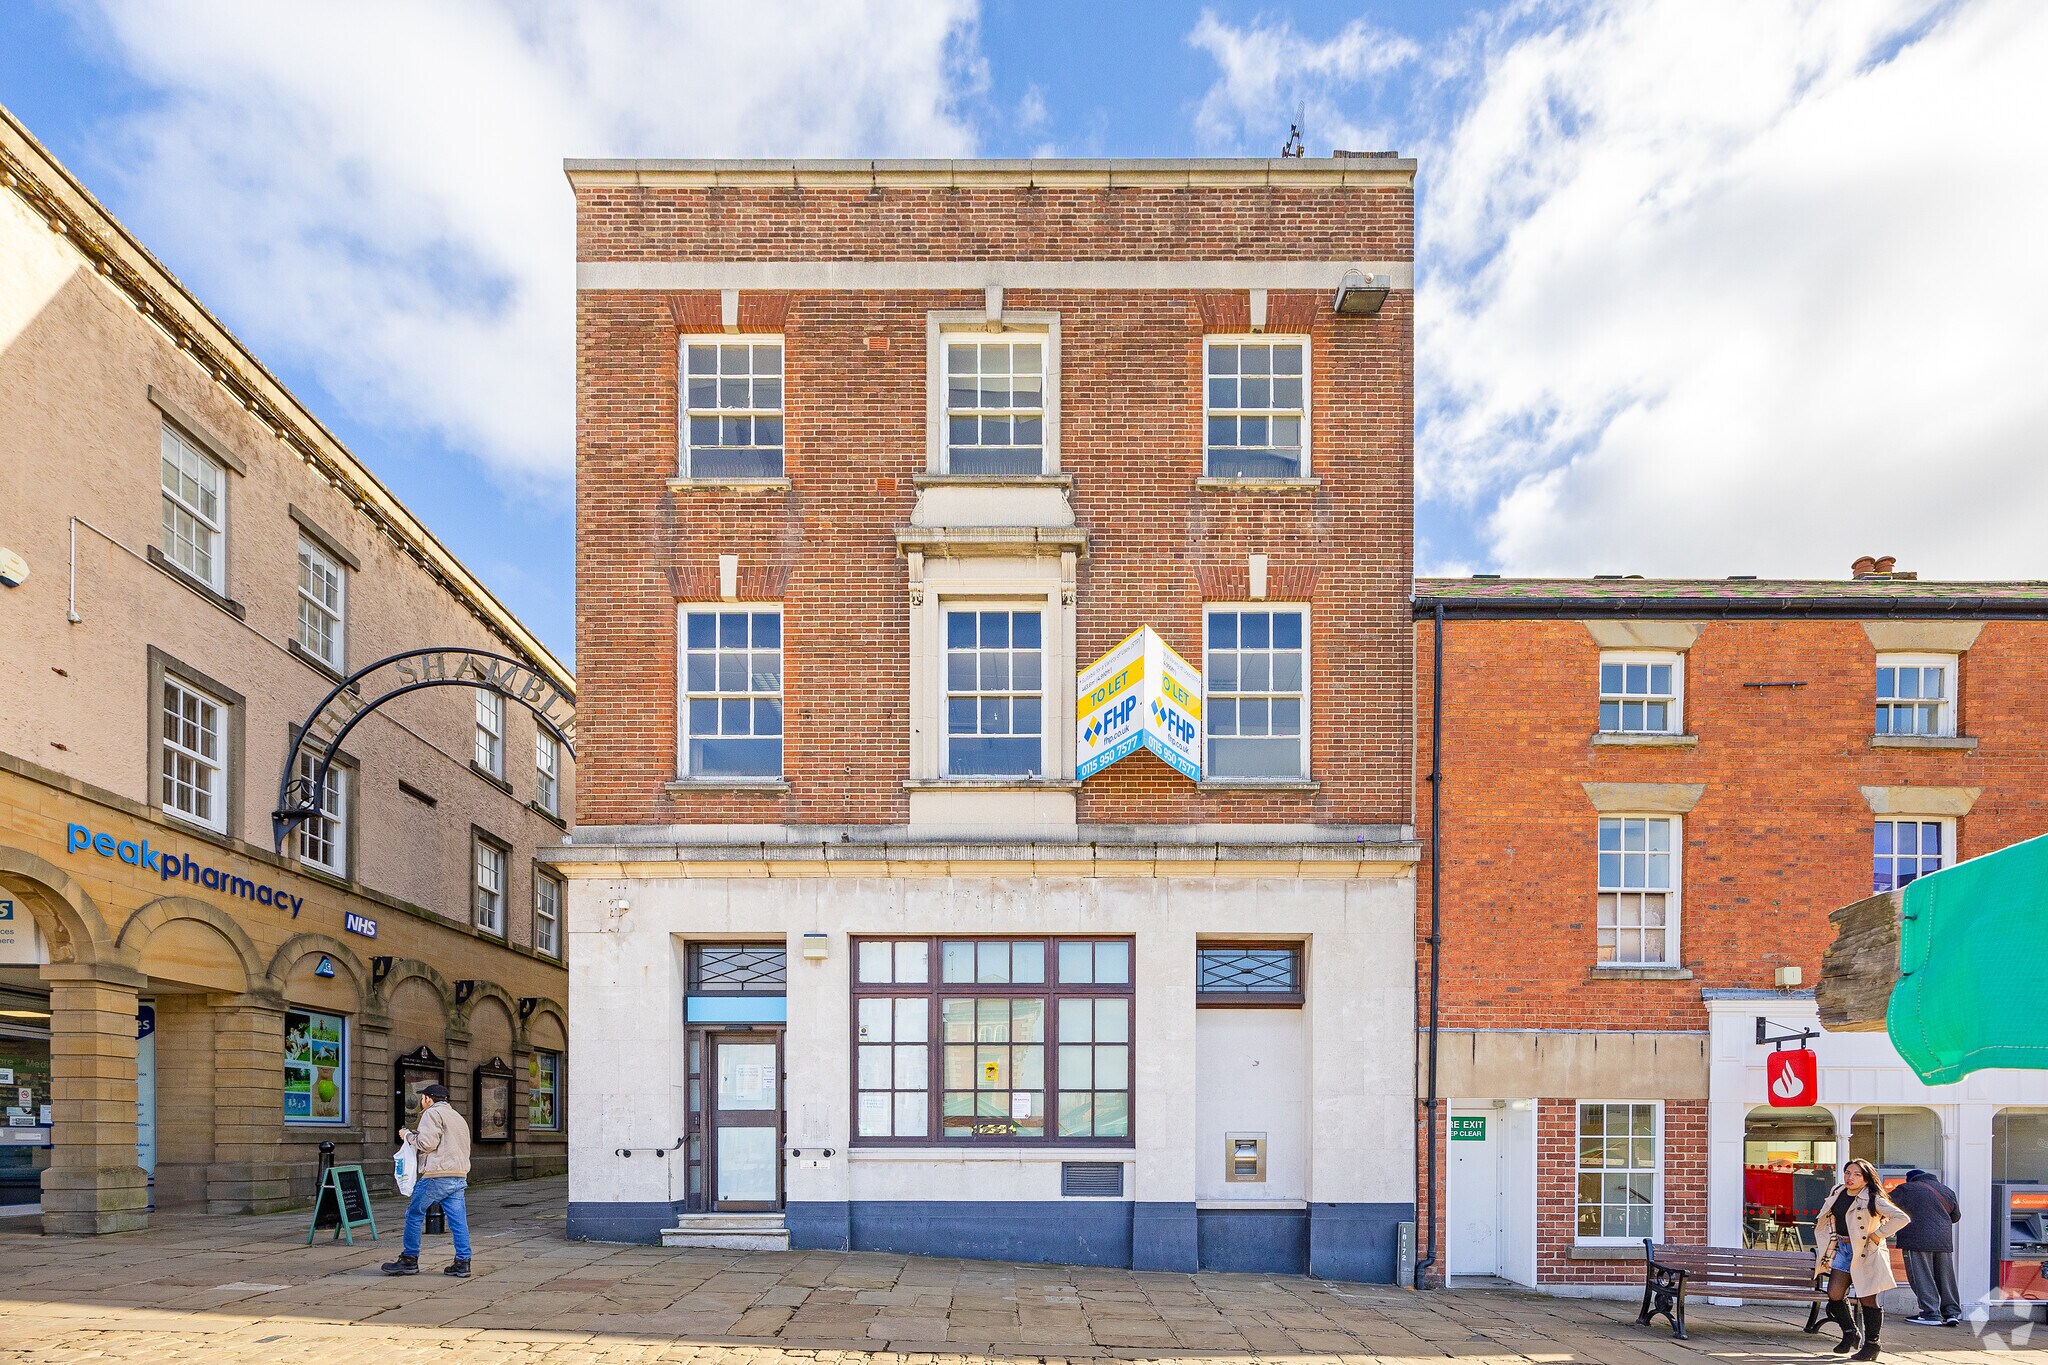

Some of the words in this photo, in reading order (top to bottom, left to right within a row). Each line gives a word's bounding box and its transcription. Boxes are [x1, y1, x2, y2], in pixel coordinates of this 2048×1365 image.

[299, 684, 368, 754] THE
[396, 651, 576, 752] SHAMBLE
[1090, 687, 1106, 707] TO
[1108, 670, 1128, 695] LET
[1162, 676, 1171, 691] O
[1173, 683, 1190, 706] LET
[1103, 694, 1137, 736] FHP
[1168, 707, 1195, 745] FHP
[1103, 724, 1130, 745] fhp.co.uk
[1081, 762, 1098, 776] 0115
[1100, 750, 1115, 767] 950
[1116, 735, 1138, 757] 7577
[1148, 735, 1162, 754] 0115
[1163, 747, 1177, 766] 950
[1178, 758, 1196, 776] 7577
[347, 914, 376, 936] NHS
[1463, 1120, 1484, 1129] EXIT
